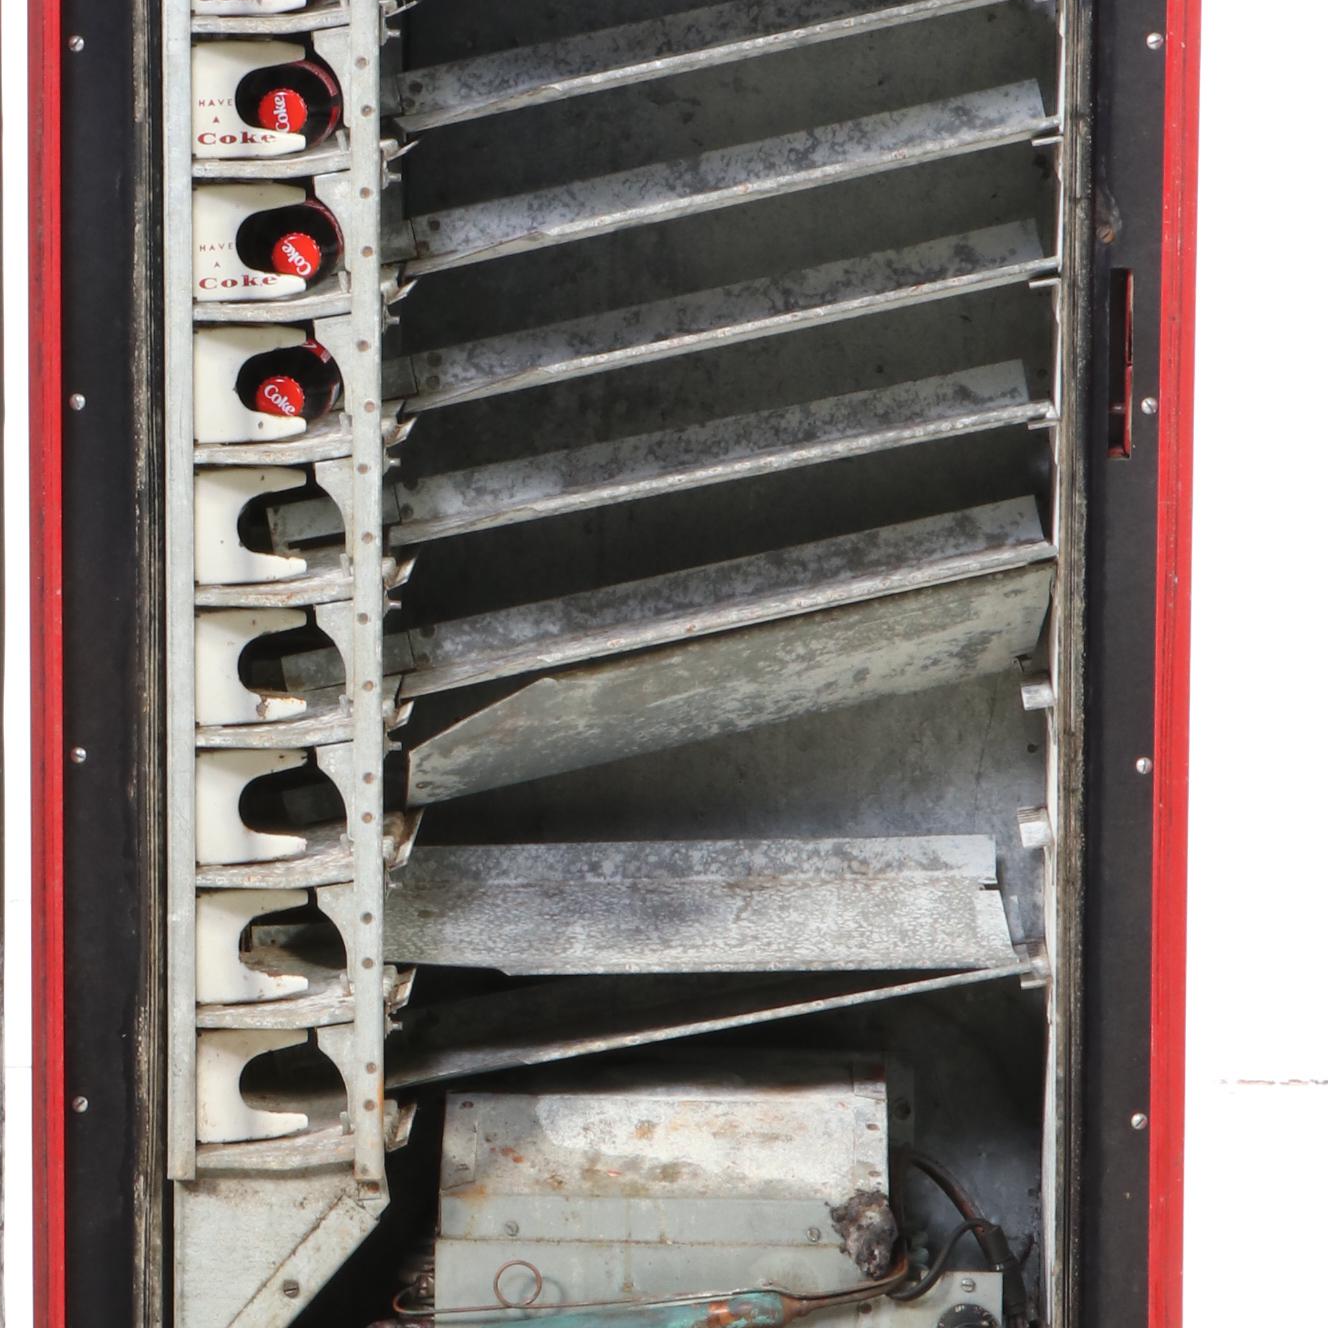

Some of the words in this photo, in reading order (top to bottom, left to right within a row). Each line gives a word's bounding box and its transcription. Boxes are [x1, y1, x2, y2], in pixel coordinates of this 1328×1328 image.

[197, 98, 233, 107] HAVE
[212, 115, 220, 123] A
[273, 95, 290, 133] Coke
[197, 131, 277, 146] Coke
[198, 243, 234, 252] HAVE
[213, 260, 221, 268] A
[282, 243, 311, 276] Coke
[198, 274, 279, 289] Coke
[264, 384, 296, 416] Coke
